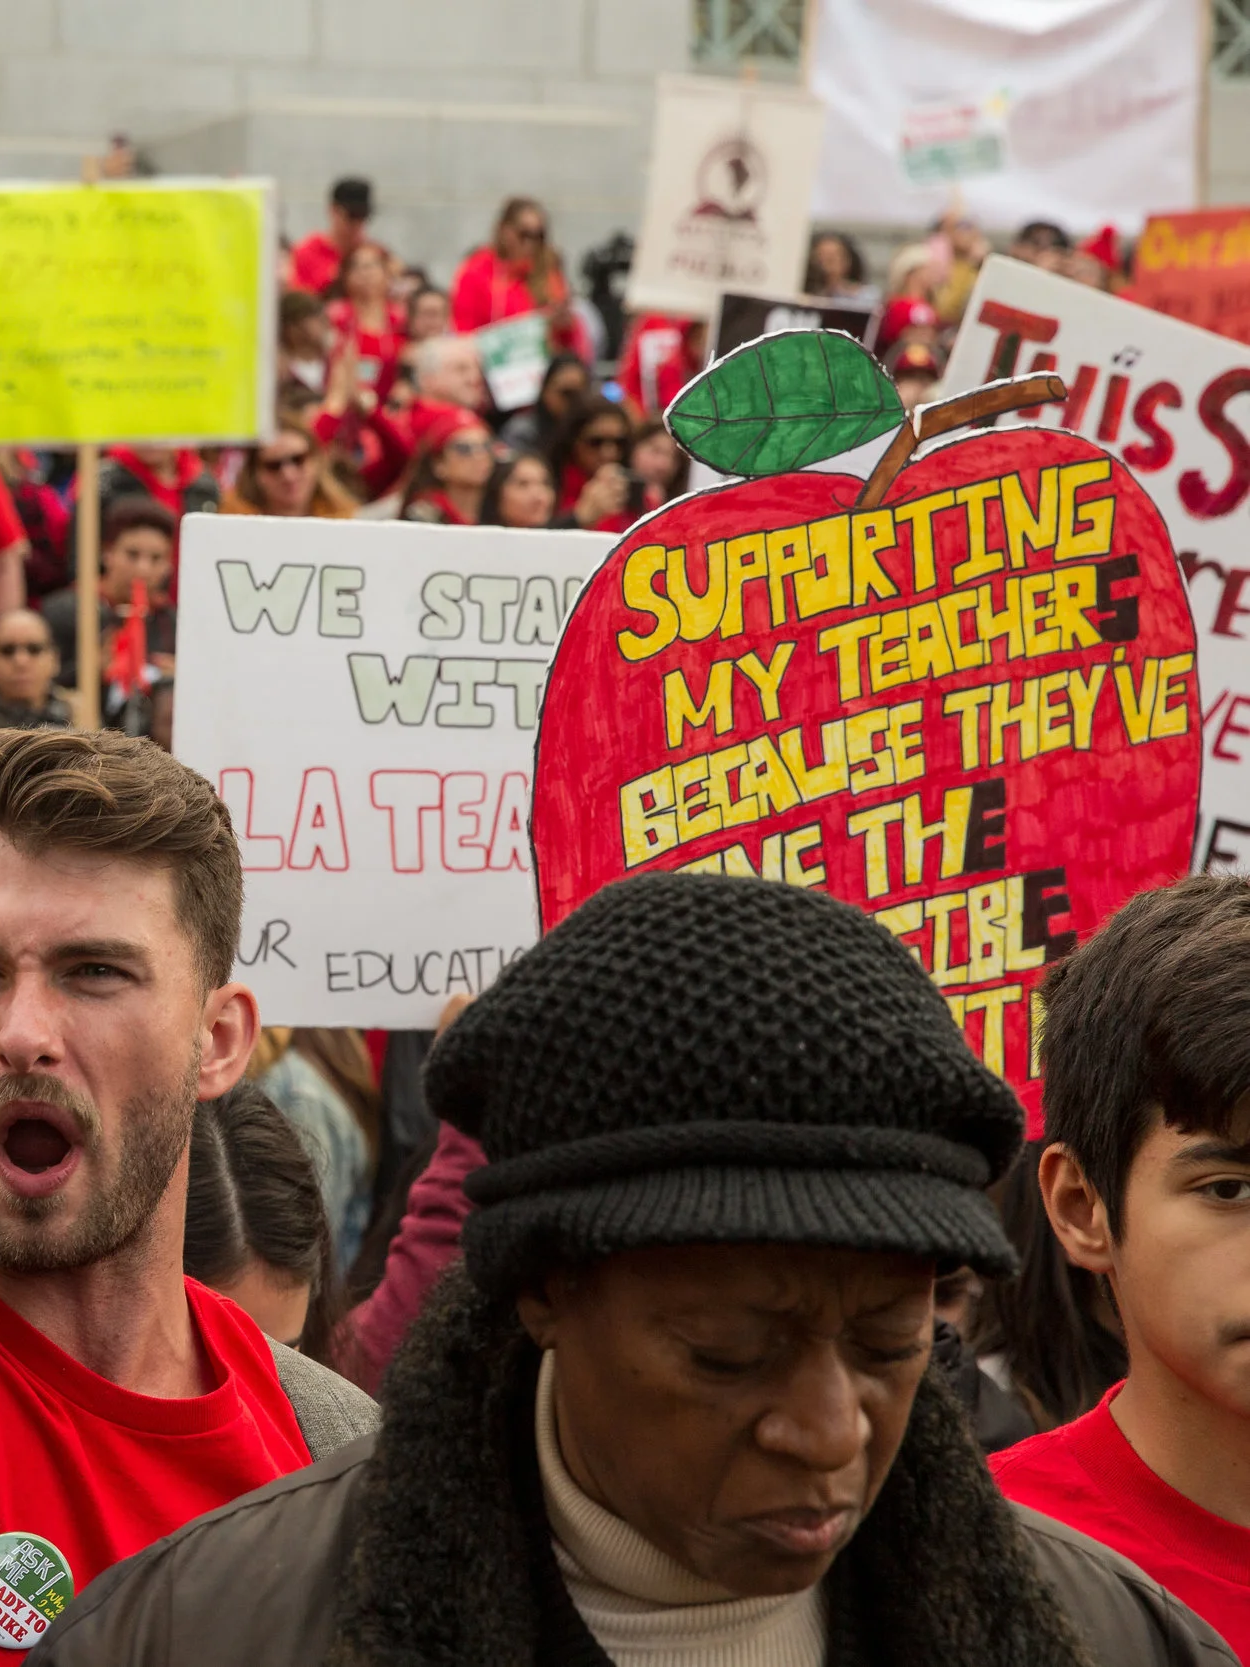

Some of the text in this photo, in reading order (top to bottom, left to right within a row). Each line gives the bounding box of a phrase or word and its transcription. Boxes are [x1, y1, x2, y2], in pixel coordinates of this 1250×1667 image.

[216, 560, 365, 638] WE
[617, 457, 1117, 662] SUPPORTING
[662, 553, 1140, 750] MY TEACHERS
[619, 700, 925, 870] BECAUSE
[942, 646, 1194, 772] THEY'VE
[218, 766, 350, 871] LA
[847, 778, 1007, 899] THE
[23, 1609, 47, 1634] TO
[46, 1588, 66, 1614] Why
